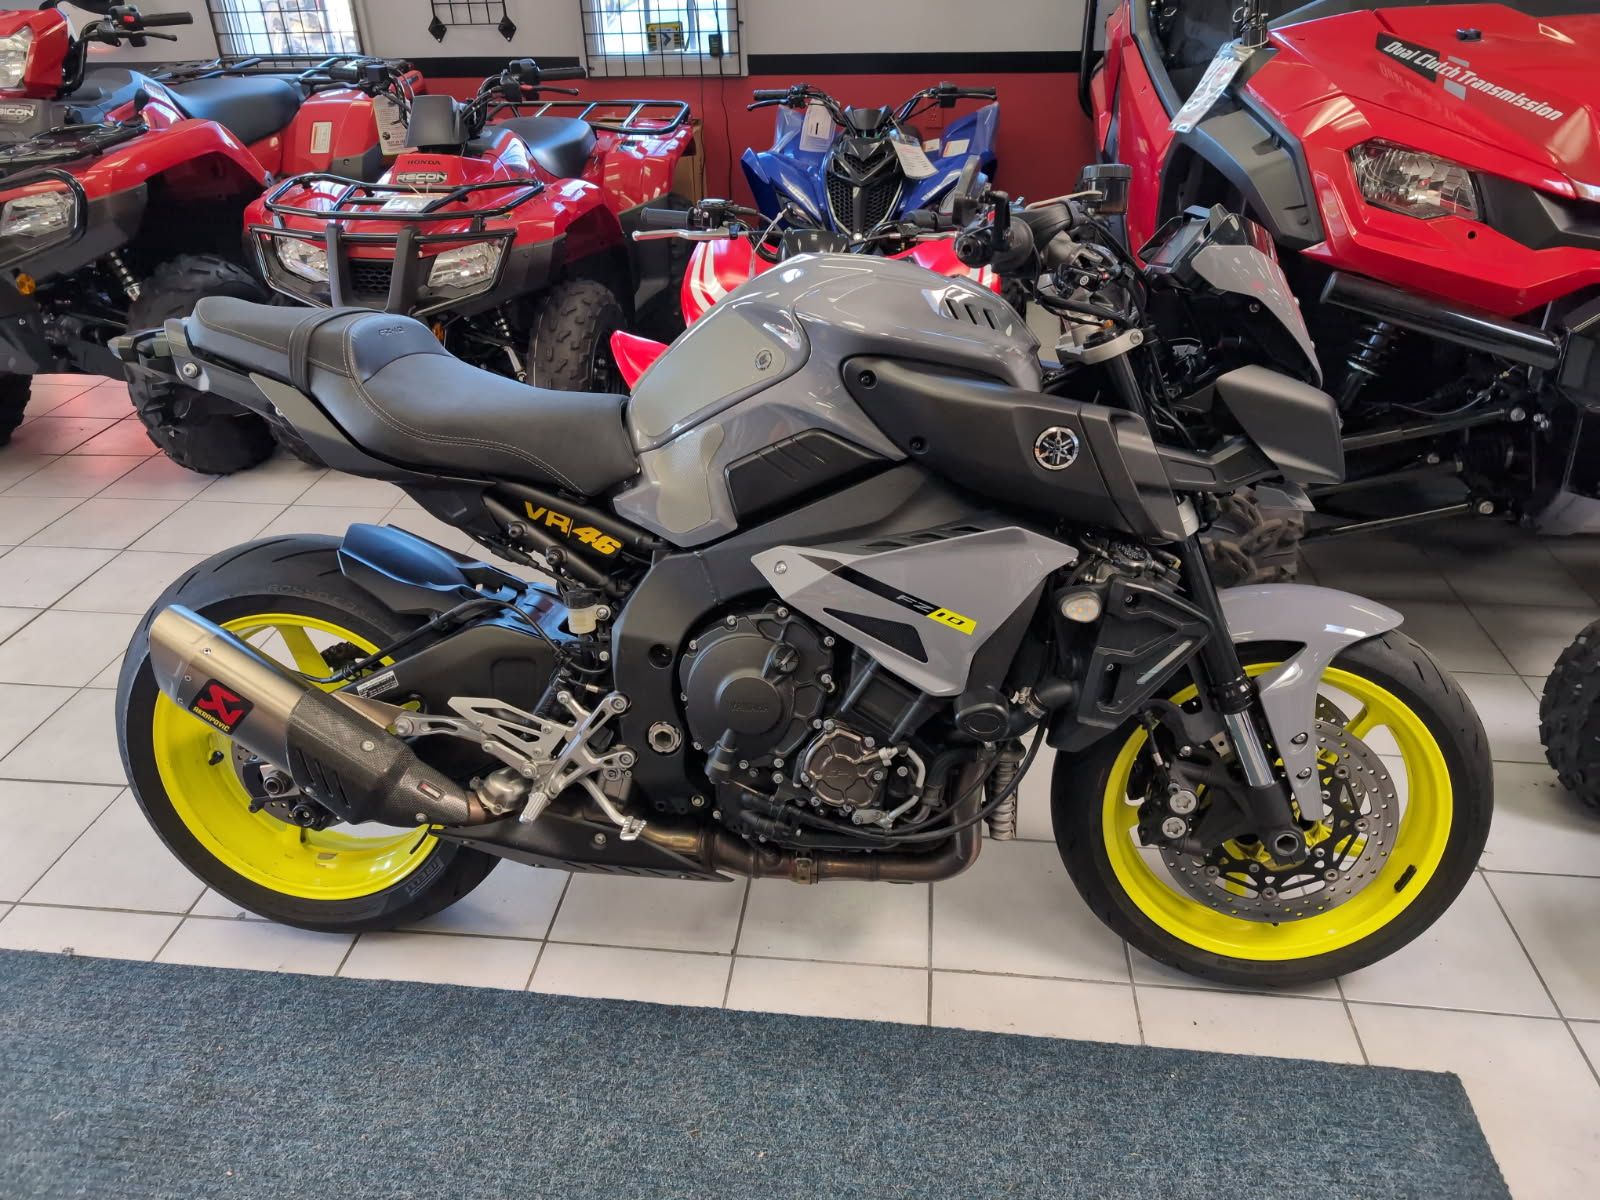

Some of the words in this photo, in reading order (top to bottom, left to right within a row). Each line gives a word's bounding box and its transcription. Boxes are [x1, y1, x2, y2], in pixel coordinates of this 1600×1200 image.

[1383, 41, 1419, 61] Dual
[1413, 53, 1462, 80] Clutch
[1457, 70, 1565, 121] Transmission
[396, 173, 448, 182] RECON
[895, 594, 935, 613] FZ
[935, 612, 966, 626] 10
